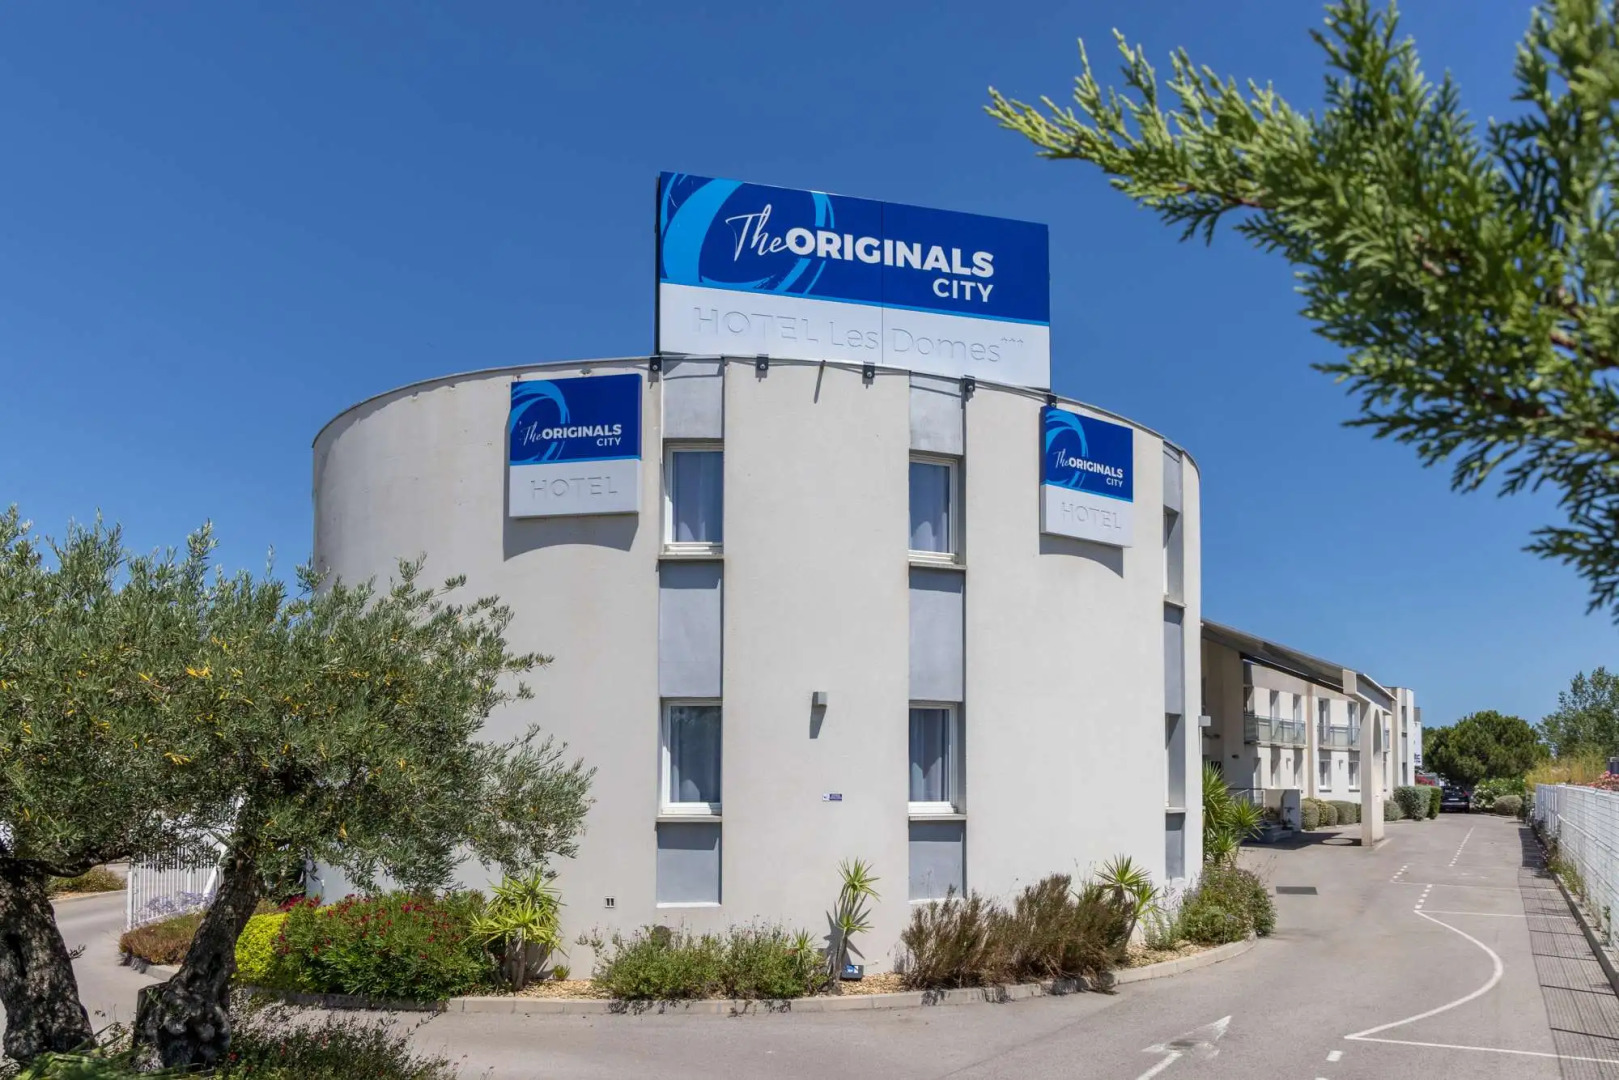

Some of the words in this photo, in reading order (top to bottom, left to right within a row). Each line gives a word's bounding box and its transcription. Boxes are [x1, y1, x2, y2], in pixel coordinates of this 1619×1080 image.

[725, 203, 789, 262] The
[785, 227, 994, 278] ORIGINALS
[932, 278, 994, 302] CITY
[693, 307, 819, 344] HOTEL
[829, 321, 879, 350] Les
[891, 328, 1001, 362] Domes
[542, 424, 622, 440] ORIGINALS
[596, 437, 622, 447] CITY
[1068, 457, 1123, 479] ORIGINALS
[531, 476, 618, 500] HOTEL
[1106, 477, 1123, 488] CITY
[1061, 501, 1122, 530] HOTEL
